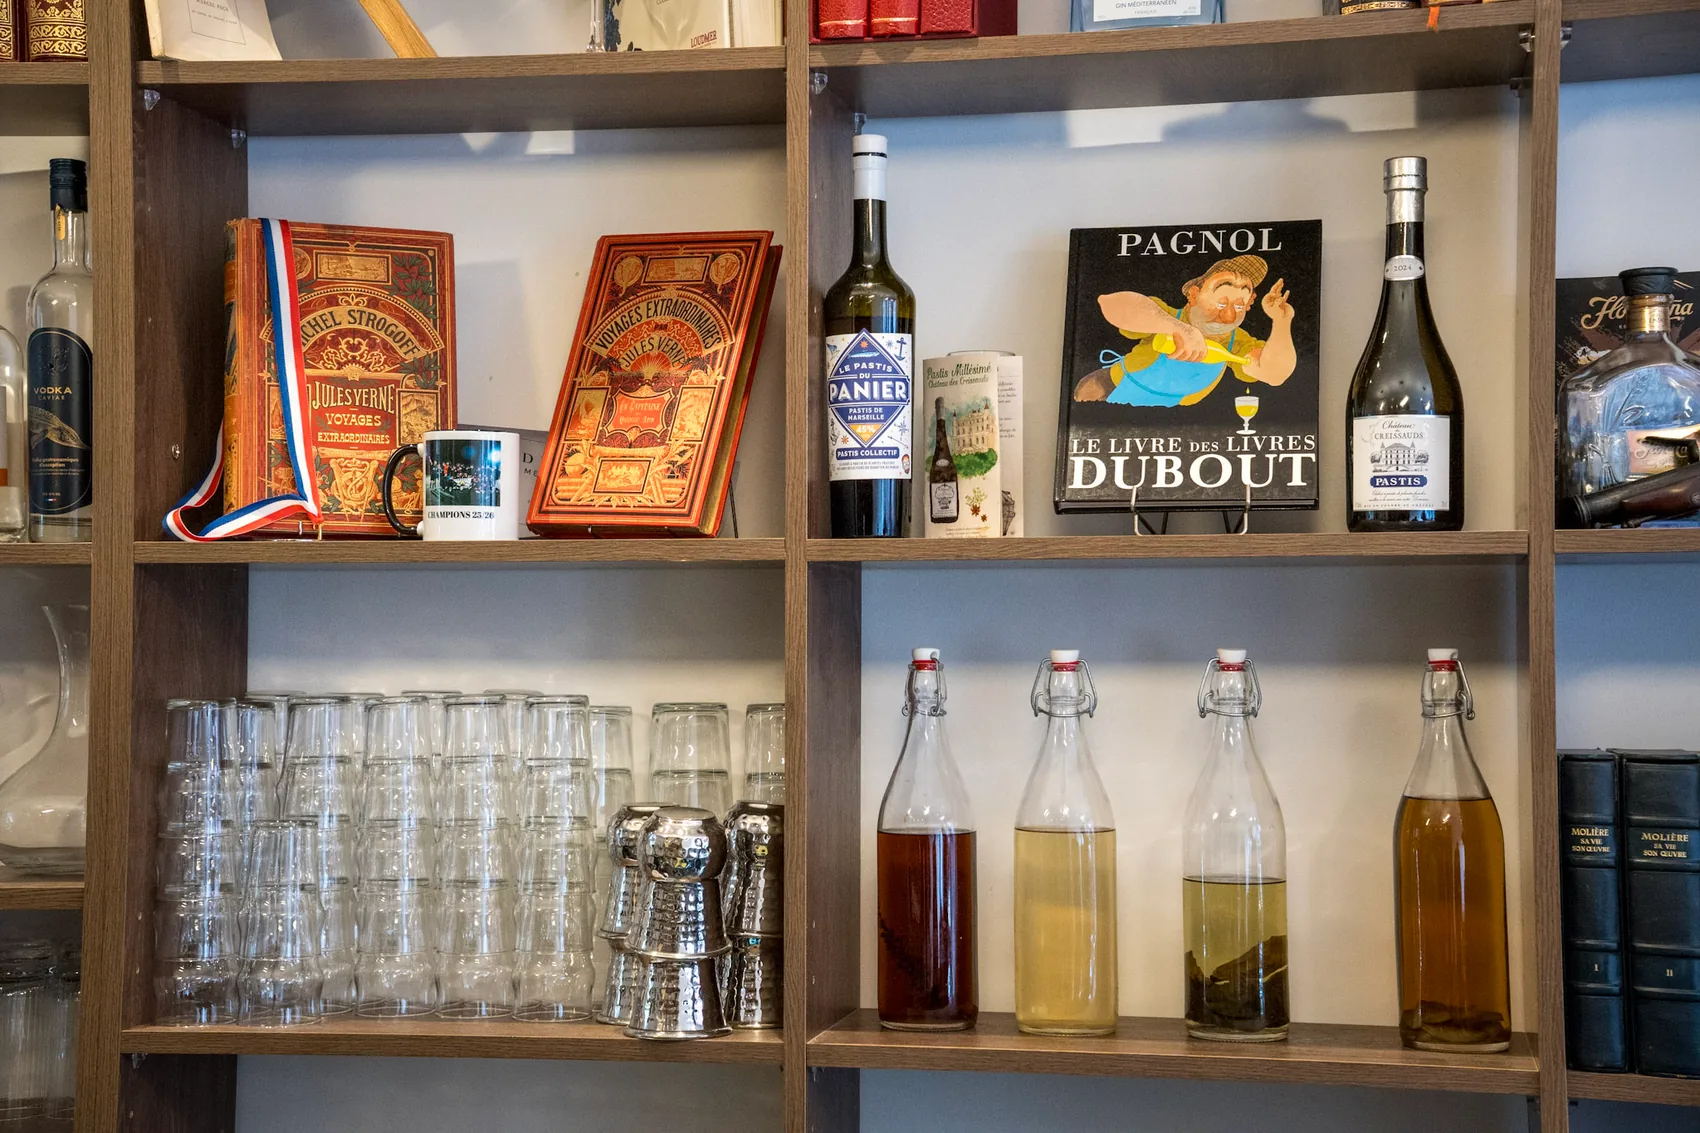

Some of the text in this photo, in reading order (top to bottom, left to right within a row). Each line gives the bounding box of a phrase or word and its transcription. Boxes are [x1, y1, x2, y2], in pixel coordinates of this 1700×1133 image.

[691, 30, 718, 48] LOUDMER
[1117, 228, 1282, 256] PAGNOL
[1581, 296, 1627, 329] Flo
[595, 298, 721, 350] VOYAGES EXTRAORDINAIRES
[300, 309, 421, 357] ICHEL STROGOFF
[621, 336, 686, 368] JULES VERNE
[839, 362, 893, 374] LE PASTIS
[927, 362, 992, 380] Pastis Millésimé
[33, 386, 73, 394] VODKA
[829, 380, 908, 402] PANIER
[312, 381, 395, 414] JULES VERNE
[325, 412, 382, 426] VOYAGES
[1382, 420, 1416, 429] Château
[856, 425, 877, 433] 45%
[317, 432, 390, 444] EXTRAORDINAIRES
[1374, 432, 1423, 440] CREISSAUDS
[1072, 435, 1316, 454] LE LIVRE DES LIVRES
[860, 449, 898, 457] COLLECTIF
[1068, 453, 1316, 489] DUBOUT
[1375, 477, 1422, 486] PASTIS
[427, 511, 471, 519] CHAMPIONS
[1571, 827, 1609, 837] MOLIÈRE
[1641, 832, 1689, 842] MOLIÈRE
[1643, 849, 1688, 858] SON ŒUVRE
